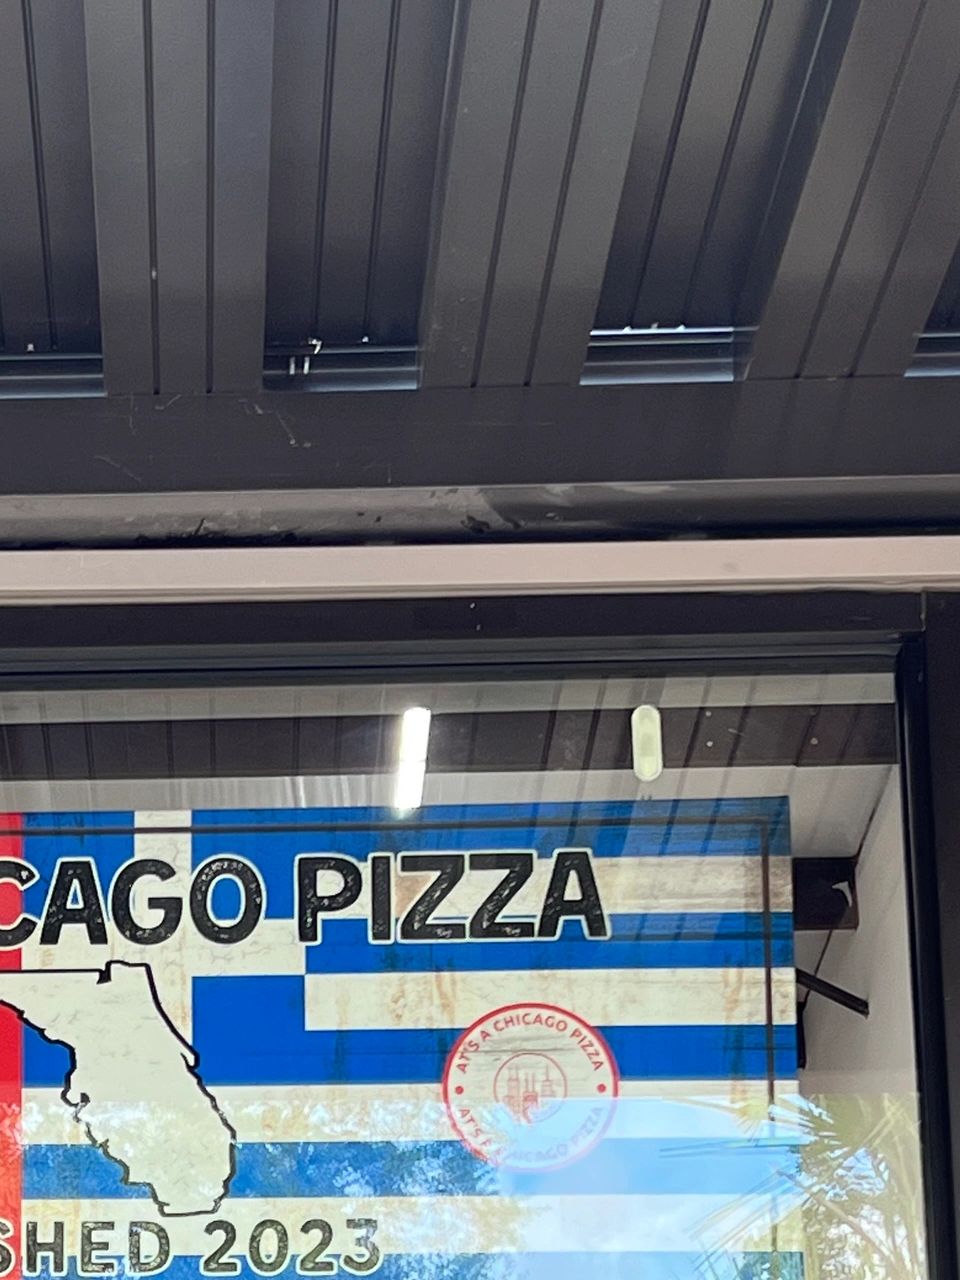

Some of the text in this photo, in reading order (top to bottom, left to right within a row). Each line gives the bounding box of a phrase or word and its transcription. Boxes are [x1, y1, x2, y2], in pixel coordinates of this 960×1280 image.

[296, 850, 609, 943] PIZZA
[480, 1030, 492, 1042] A
[493, 1012, 568, 1032] CHICAGO
[569, 1027, 604, 1071] PIZZA
[201, 1218, 383, 1276] 2023
